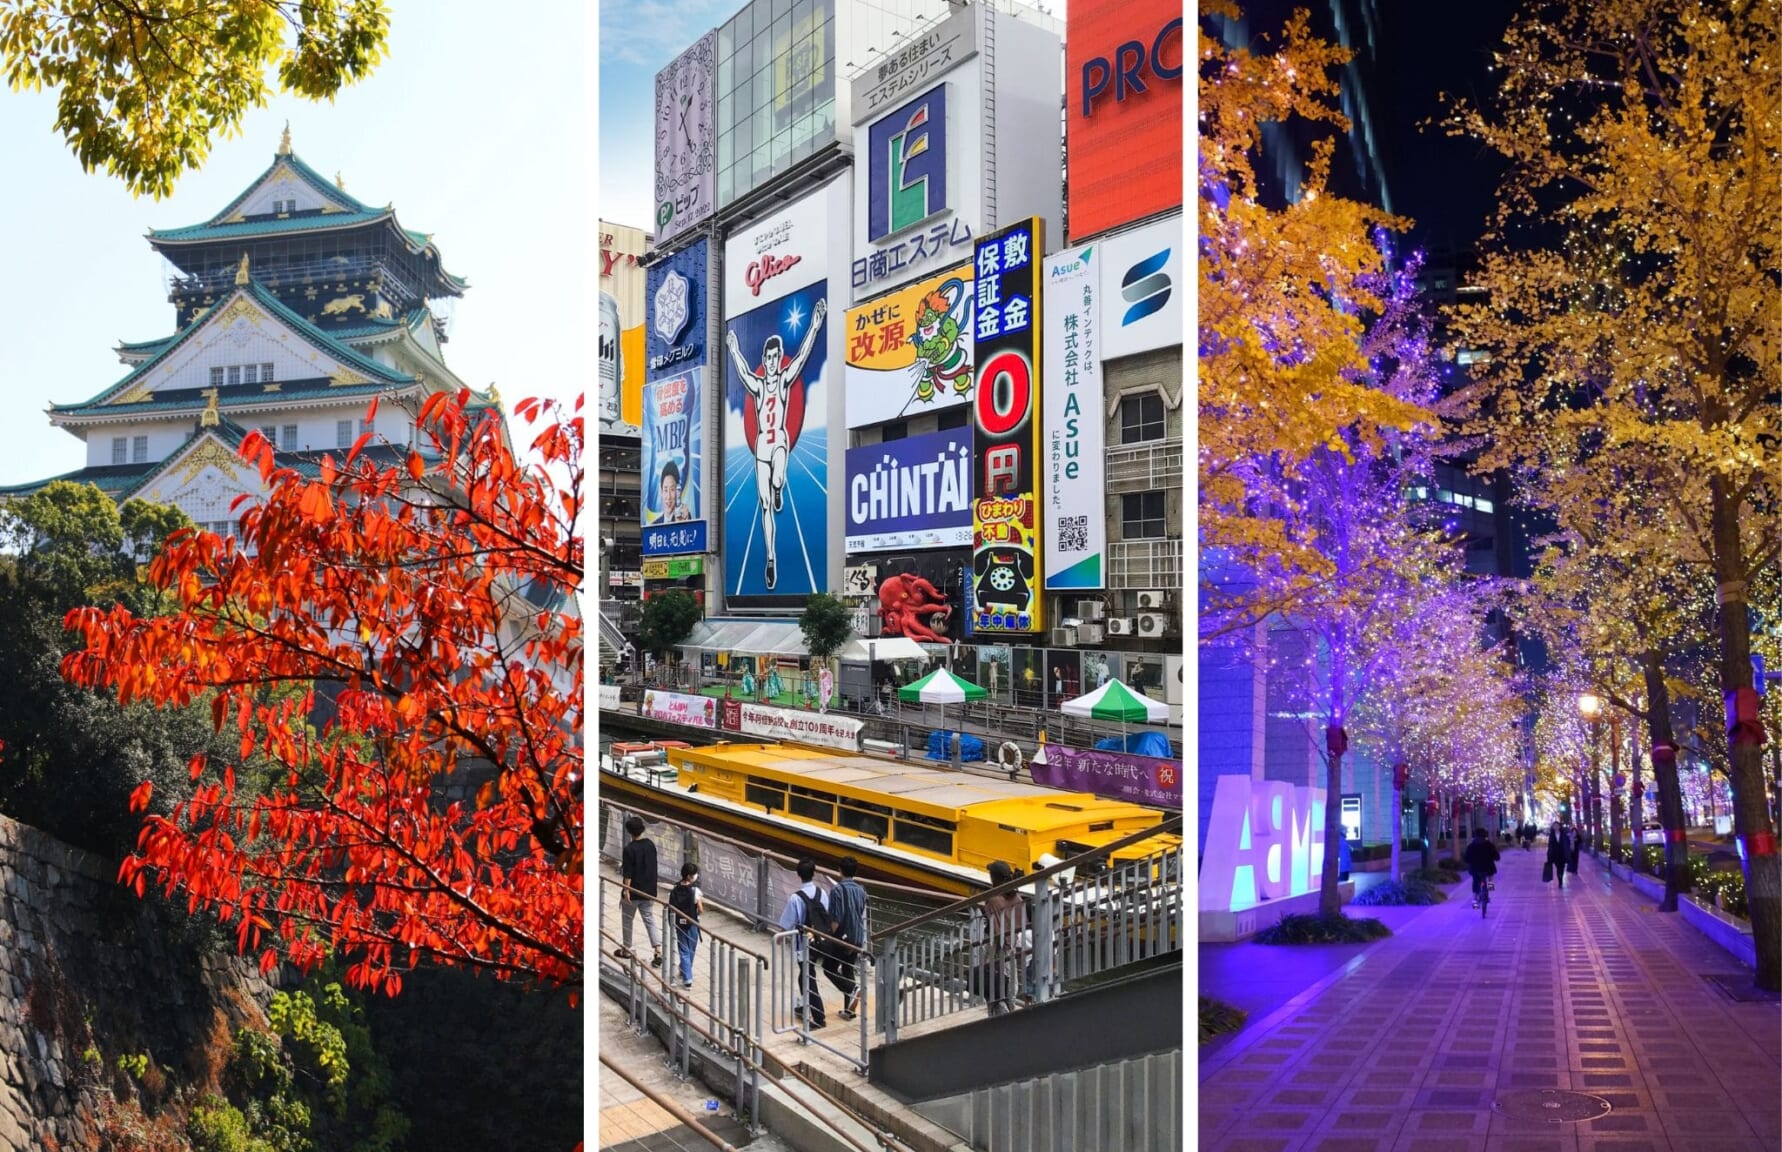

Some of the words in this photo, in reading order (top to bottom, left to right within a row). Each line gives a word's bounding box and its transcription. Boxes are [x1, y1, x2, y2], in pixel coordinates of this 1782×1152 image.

[868, 46, 953, 109] エステムシリーズ
[877, 31, 941, 82] 夢ある住まい
[852, 216, 973, 289] 日商エステム
[1051, 261, 1080, 278] Asue
[745, 254, 802, 297] Glico
[855, 304, 901, 331] かぜに
[851, 320, 905, 362] 改源
[1064, 313, 1079, 387] 株式会社
[656, 419, 687, 453] MBP
[764, 393, 777, 444] グリコ
[851, 441, 969, 525] CHINTAI
[980, 499, 1024, 520] ひまわり
[1160, 767, 1174, 784] 祝
